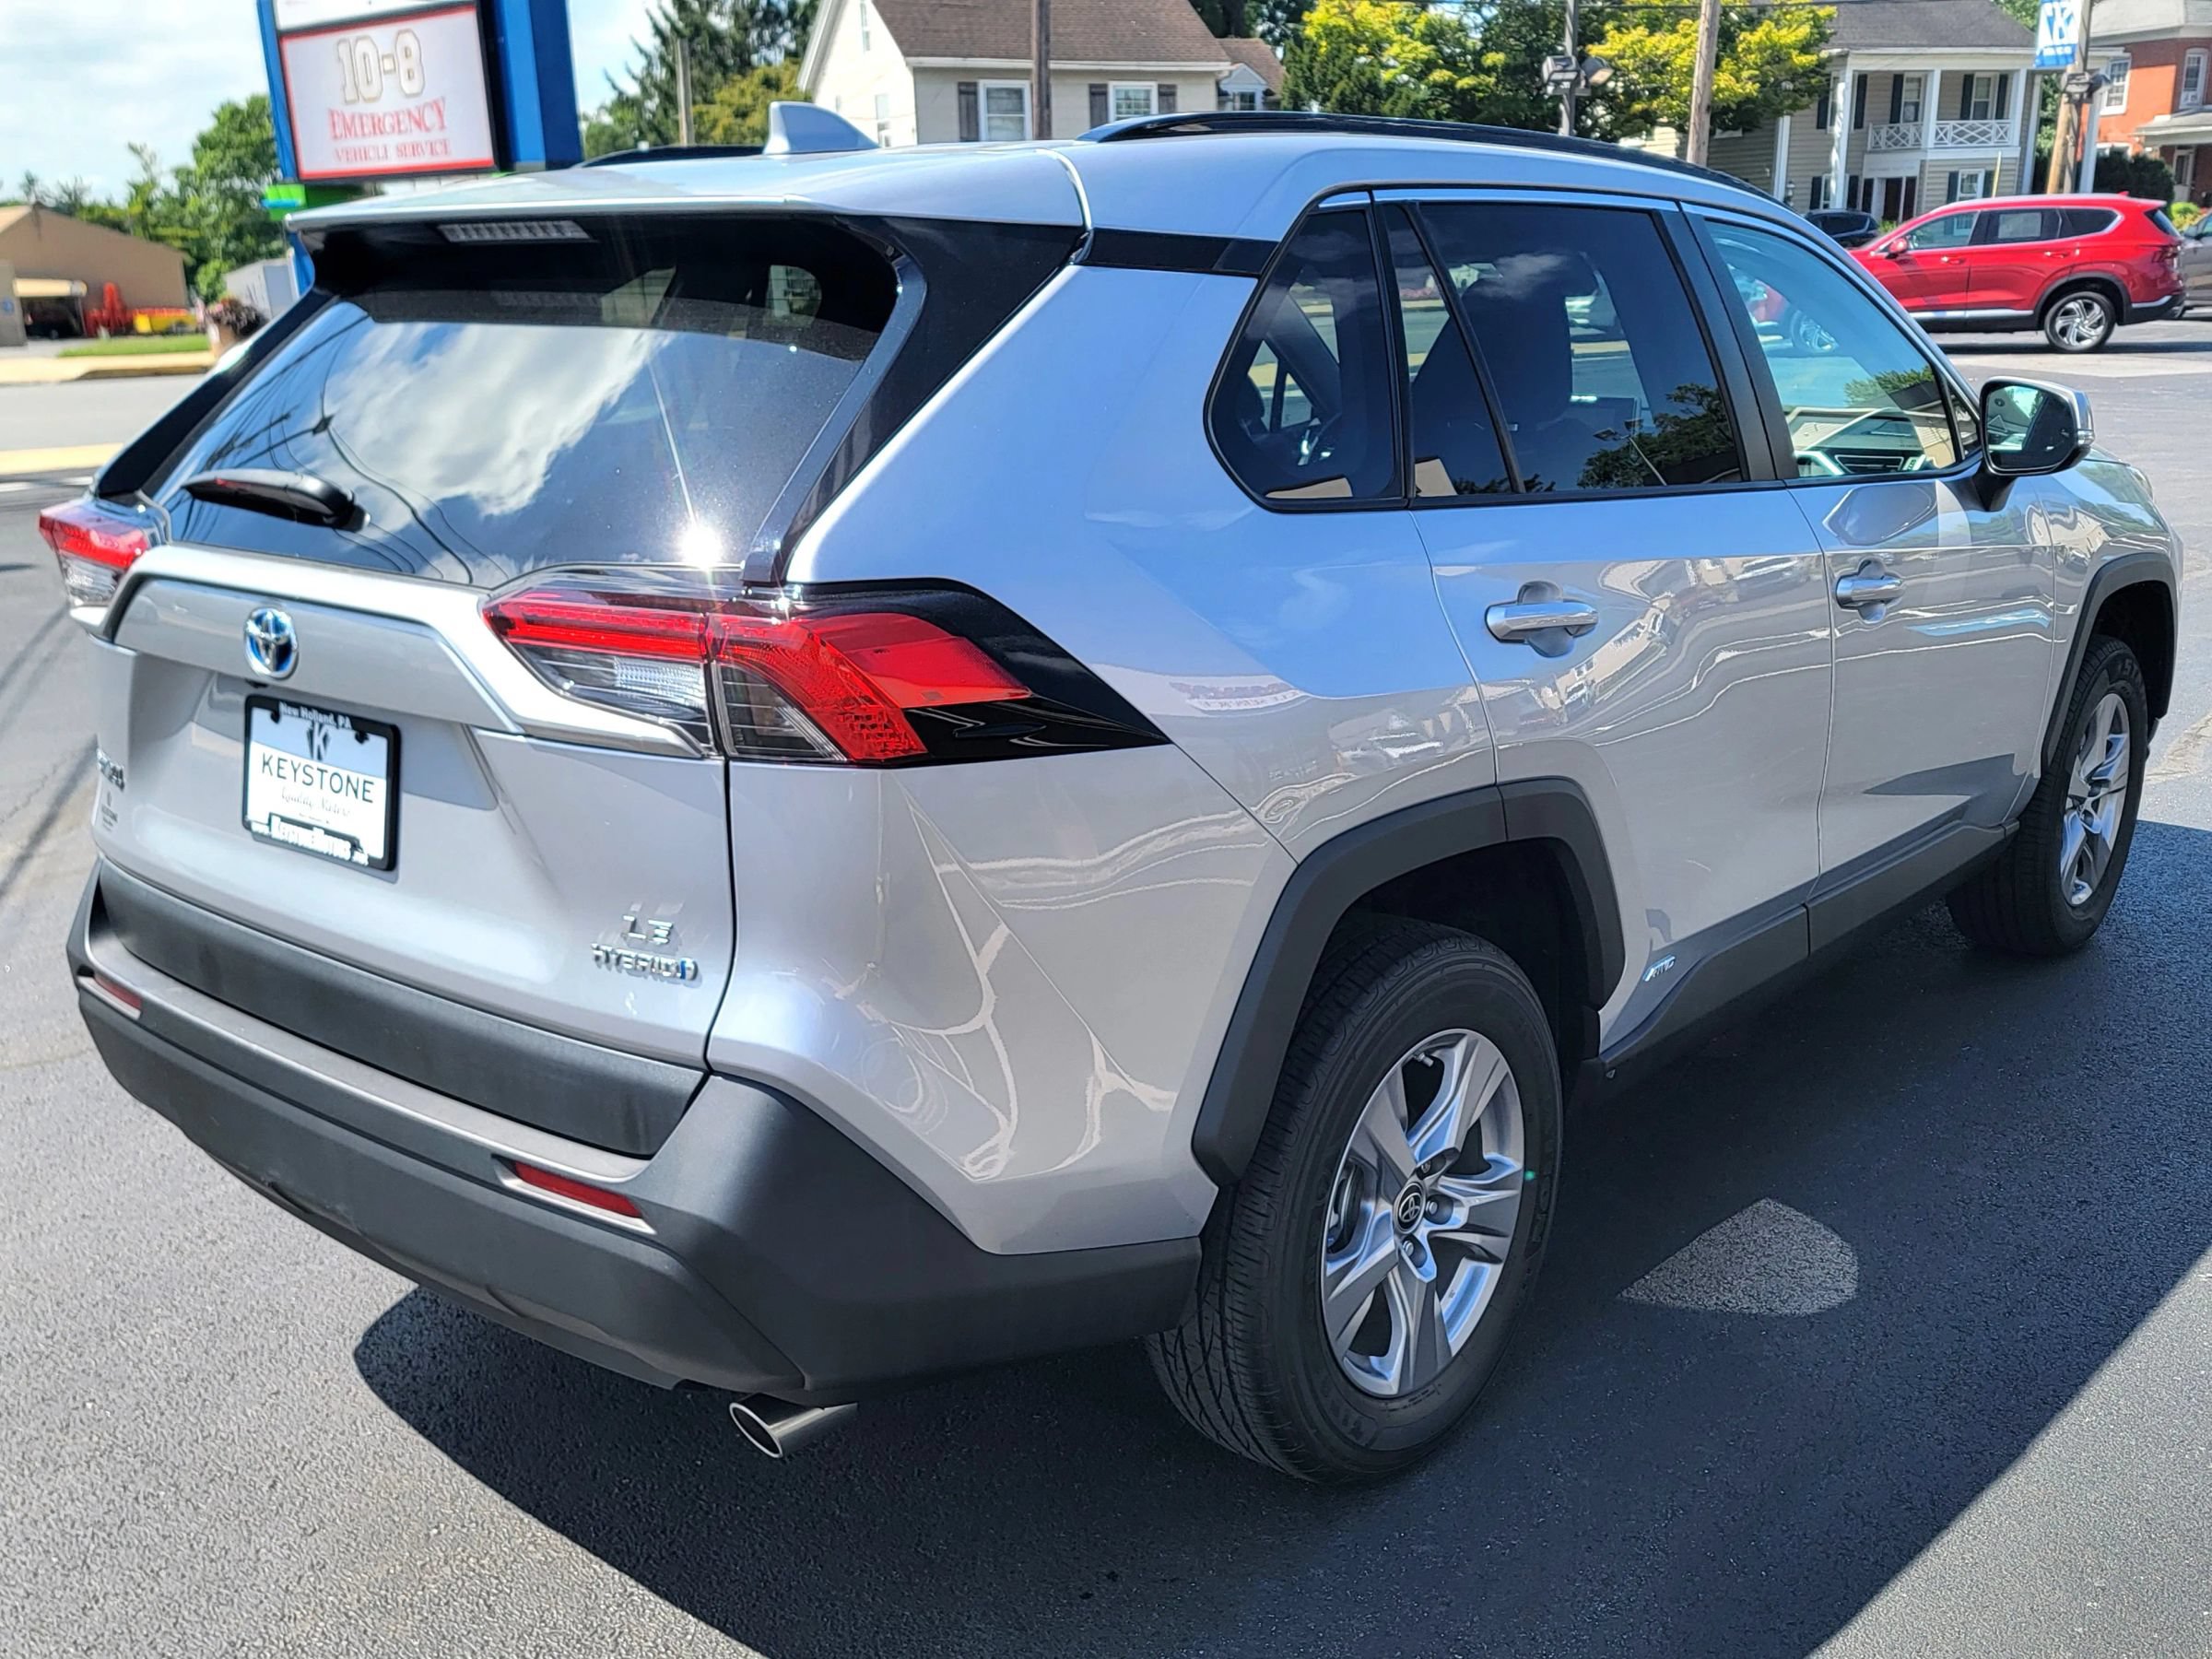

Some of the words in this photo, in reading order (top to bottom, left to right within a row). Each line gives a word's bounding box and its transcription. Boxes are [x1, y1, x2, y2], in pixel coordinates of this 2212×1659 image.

[335, 29, 426, 104] 10-8
[328, 96, 447, 139] EMERGENCY
[334, 143, 389, 162] VEHICLE
[396, 138, 451, 159] SERVICE
[279, 700, 300, 718] New
[262, 751, 375, 804] KEYSTONE
